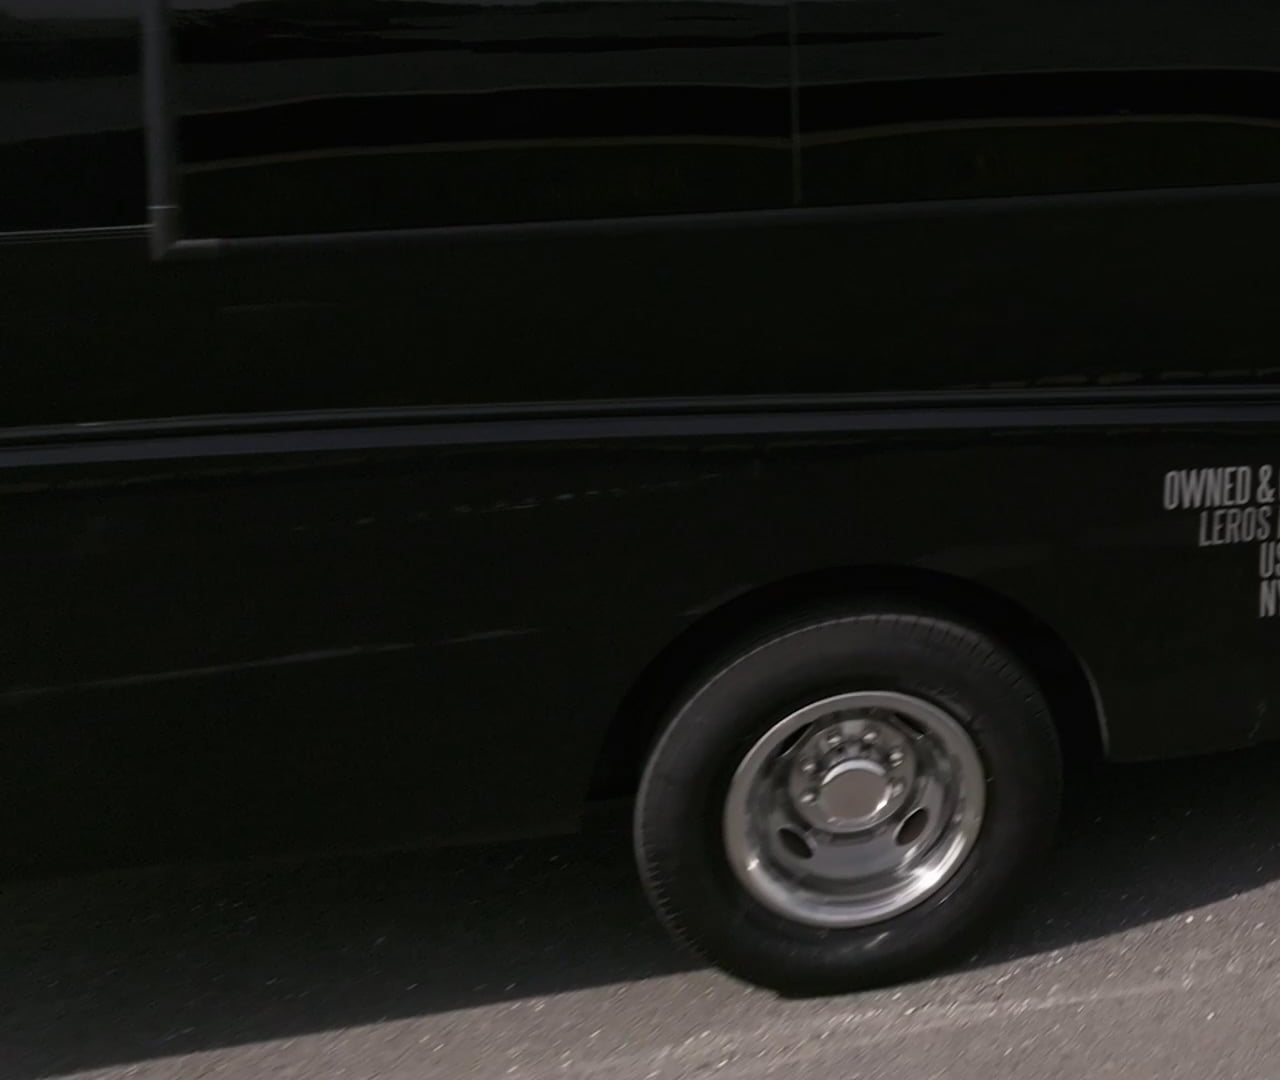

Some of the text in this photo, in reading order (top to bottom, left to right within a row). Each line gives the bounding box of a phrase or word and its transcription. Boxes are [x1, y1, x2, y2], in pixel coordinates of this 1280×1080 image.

[1163, 466, 1251, 509] OWNED
[1257, 465, 1275, 502] &
[1199, 506, 1272, 546] LEROS
